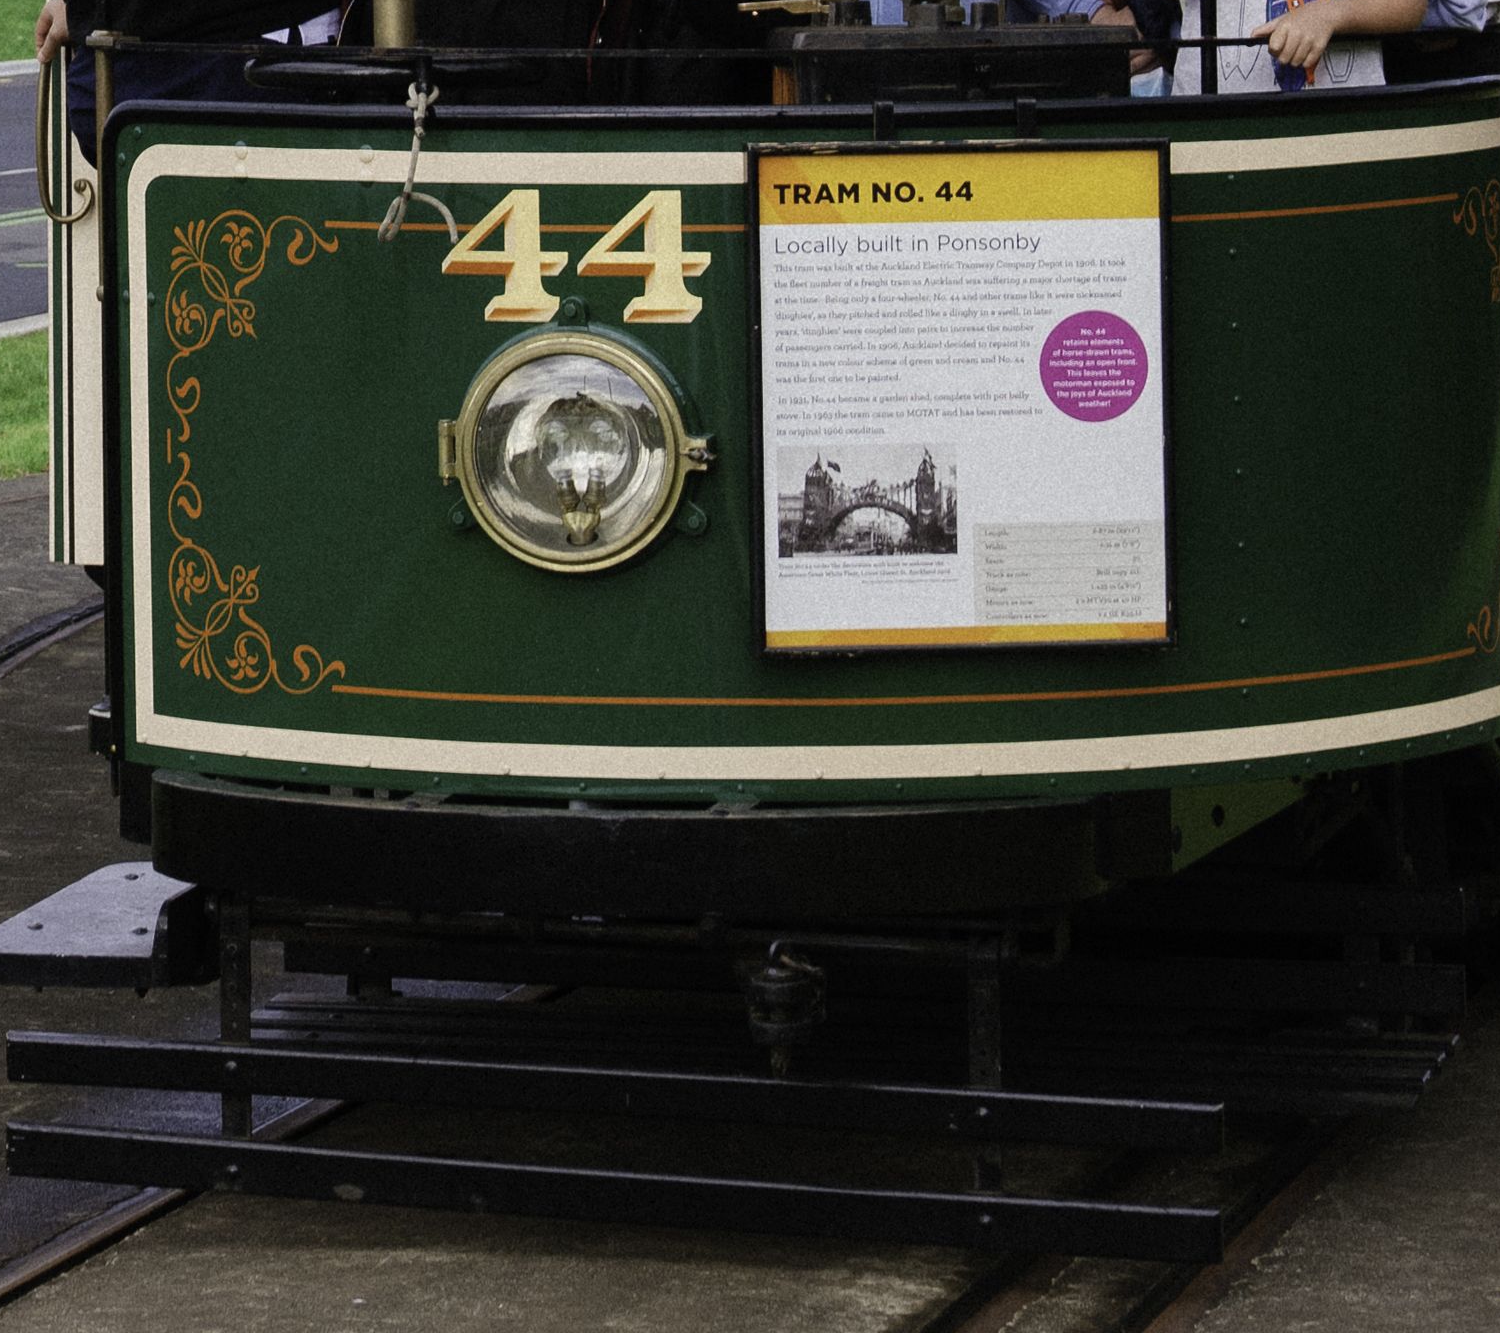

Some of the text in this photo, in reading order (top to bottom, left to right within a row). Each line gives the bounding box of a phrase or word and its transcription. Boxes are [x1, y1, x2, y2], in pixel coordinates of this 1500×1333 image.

[774, 181, 973, 204] TRAM NO. 44
[775, 234, 1041, 256] Locally built in Ponsonby
[442, 189, 711, 323] 44
[774, 264, 792, 272] This
[794, 263, 814, 272] tram
[834, 263, 854, 271] built
[865, 262, 879, 271] the
[881, 262, 920, 271] Auckland
[923, 261, 954, 270] Electric
[957, 260, 994, 272] Tramway
[996, 259, 1036, 271] Company
[1038, 259, 1062, 270] Depot
[1076, 258, 1097, 269] 1906.
[1108, 258, 1126, 267] took
[774, 279, 787, 288] the
[790, 279, 807, 288] fleet
[810, 278, 841, 287] number
[861, 278, 888, 289] freight
[890, 277, 910, 286] tram
[924, 276, 963, 285] Auckland
[983, 275, 1020, 287] suffering
[1029, 275, 1053, 286] major
[1055, 274, 1090, 286] shortage
[1103, 274, 1127, 282] trams
[784, 295, 798, 303] the
[800, 294, 820, 303] time.
[825, 294, 849, 305] Being
[851, 294, 869, 305] only
[878, 293, 931, 304] four-wheeler,
[933, 292, 947, 301] No.
[962, 292, 977, 300] and
[979, 291, 1000, 300] other
[1003, 291, 1027, 300] trams
[1030, 291, 1045, 299] like
[1076, 289, 1122, 299] nicknamed
[774, 307, 1052, 322] 'dinghies', they pitched and rolled like dinghy swell. later
[775, 328, 799, 337] years,
[800, 325, 841, 337] 'dinghies'
[864, 324, 897, 336] coupled
[899, 324, 915, 333] into
[918, 324, 938, 335] pairs
[950, 324, 984, 332] increase
[987, 323, 1000, 331] the
[1002, 322, 1034, 331] number
[785, 339, 1018, 354] passengers carried. 1906, Auckland decided repaint
[1111, 348, 1135, 356] trams,
[775, 358, 799, 367] trams
[838, 357, 864, 366] colour
[866, 357, 897, 366] scheme
[909, 359, 933, 368] green
[936, 356, 951, 365] and
[981, 355, 996, 364] and
[998, 355, 1011, 364] No.
[794, 374, 807, 383] the
[809, 374, 825, 382] first
[867, 372, 900, 384] painted.
[1094, 379, 1125, 387] exposed
[790, 391, 1029, 406] 1931, became garden shed, complete with pot belly
[1057, 390, 1069, 398] the
[776, 411, 800, 420] stove.
[814, 410, 832, 421] 1963
[835, 410, 848, 418] the
[850, 409, 870, 418] tram
[907, 408, 940, 417] MOTAT
[942, 407, 958, 416] and
[960, 407, 974, 416] has
[976, 407, 997, 415] been
[998, 406, 1032, 415] restored
